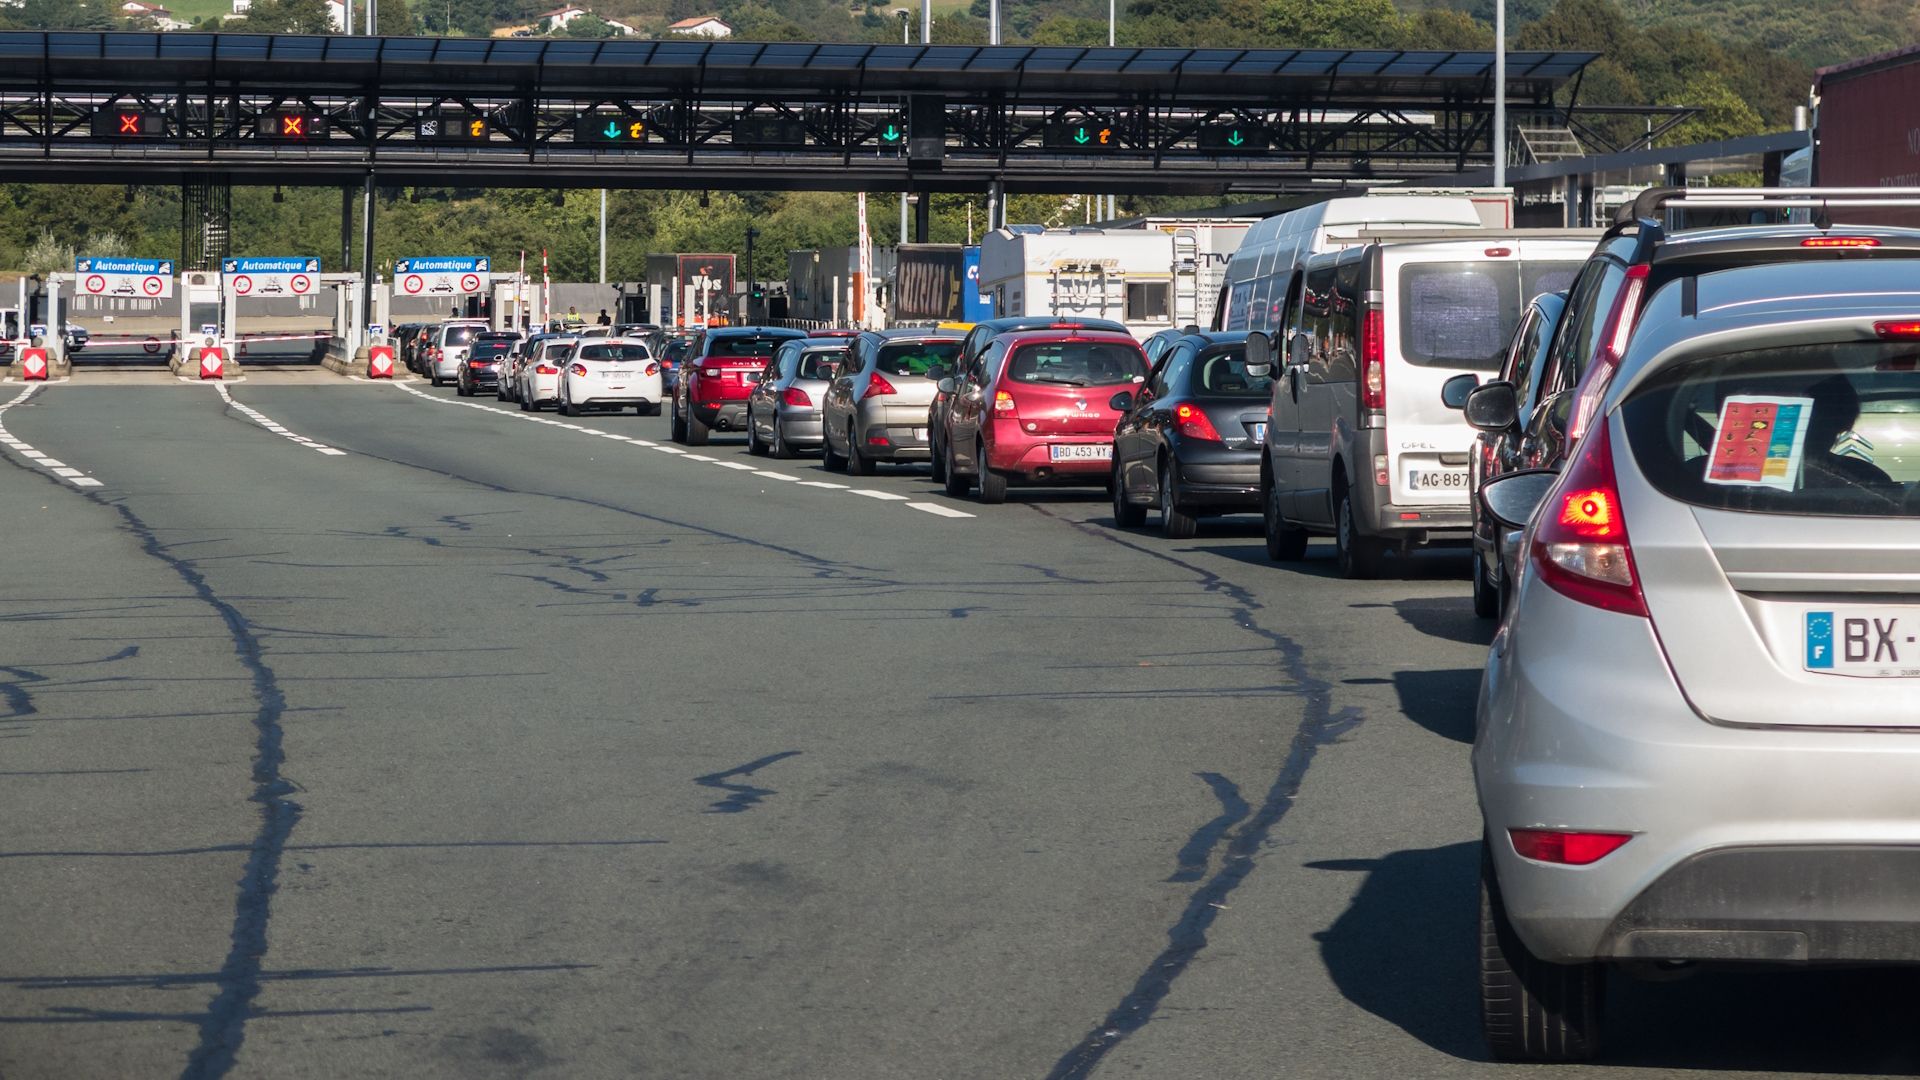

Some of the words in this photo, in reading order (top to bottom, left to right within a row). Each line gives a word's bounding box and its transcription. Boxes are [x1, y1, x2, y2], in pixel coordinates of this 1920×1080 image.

[95, 260, 155, 273] Automatique
[241, 260, 302, 272] Automatique
[412, 259, 472, 271] Automatique
[1814, 645, 1826, 660] F
